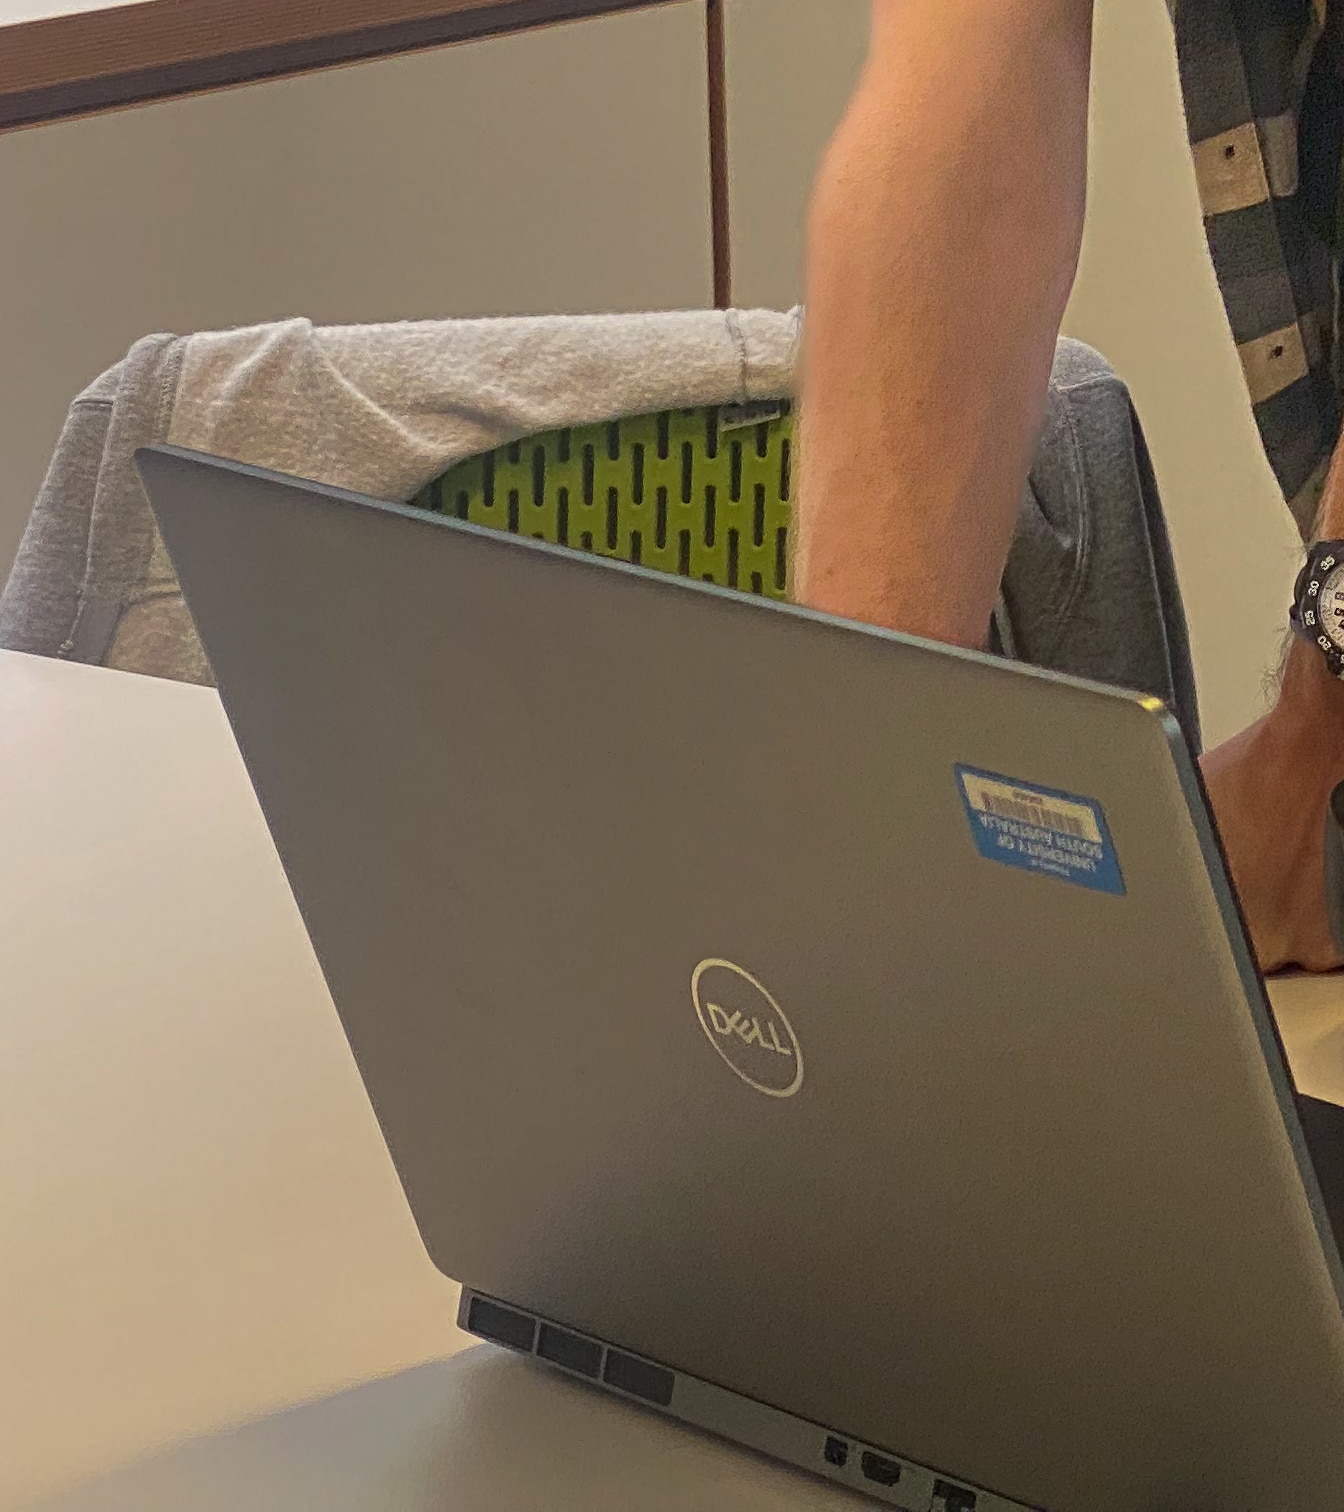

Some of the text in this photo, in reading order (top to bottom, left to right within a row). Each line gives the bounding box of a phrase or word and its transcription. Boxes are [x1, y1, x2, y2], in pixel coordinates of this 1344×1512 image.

[1320, 555, 1336, 571] 35
[1304, 610, 1316, 626] 25
[1317, 635, 1332, 651] 20
[706, 1001, 792, 1056] DELL
